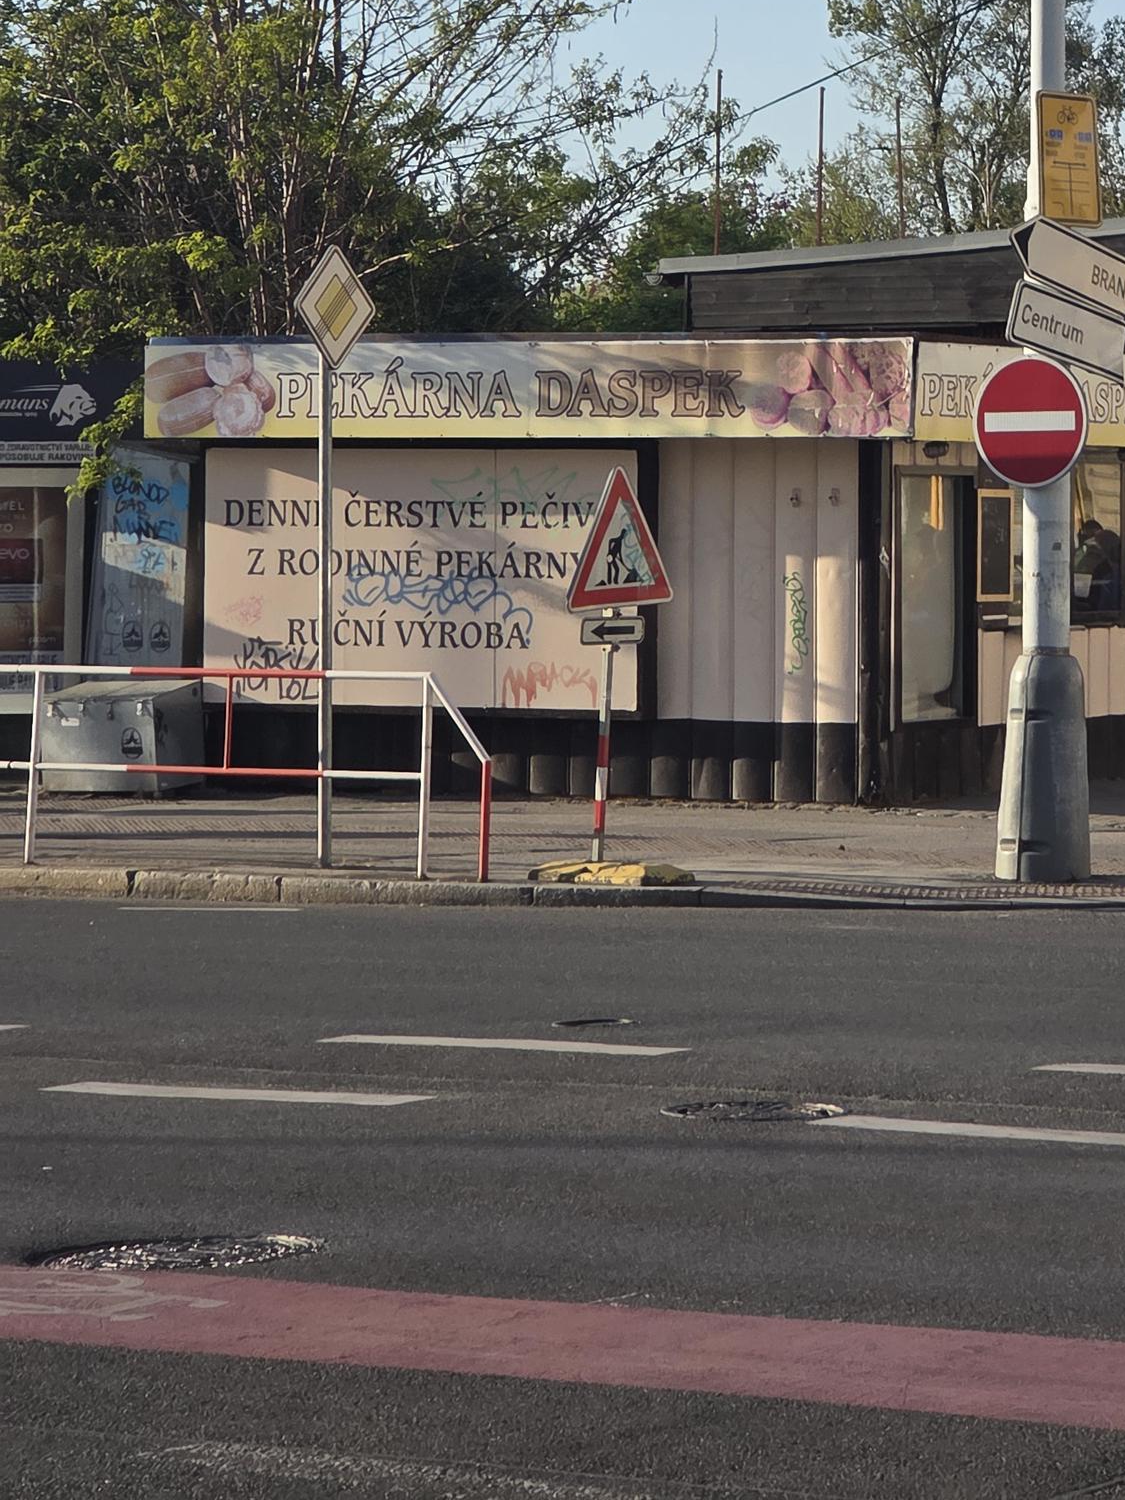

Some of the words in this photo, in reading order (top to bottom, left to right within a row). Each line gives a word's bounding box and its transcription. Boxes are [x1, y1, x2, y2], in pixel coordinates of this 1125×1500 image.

[1021, 303, 1084, 345] Centrum
[276, 356, 521, 419] PEKÁRNA
[535, 368, 745, 418] DASPEK
[224, 499, 319, 527] DENN
[345, 491, 487, 528] ČERSTVÉ
[501, 492, 594, 529] PEČIV
[247, 549, 265, 576] Z
[395, 610, 529, 649] VÝROBA
